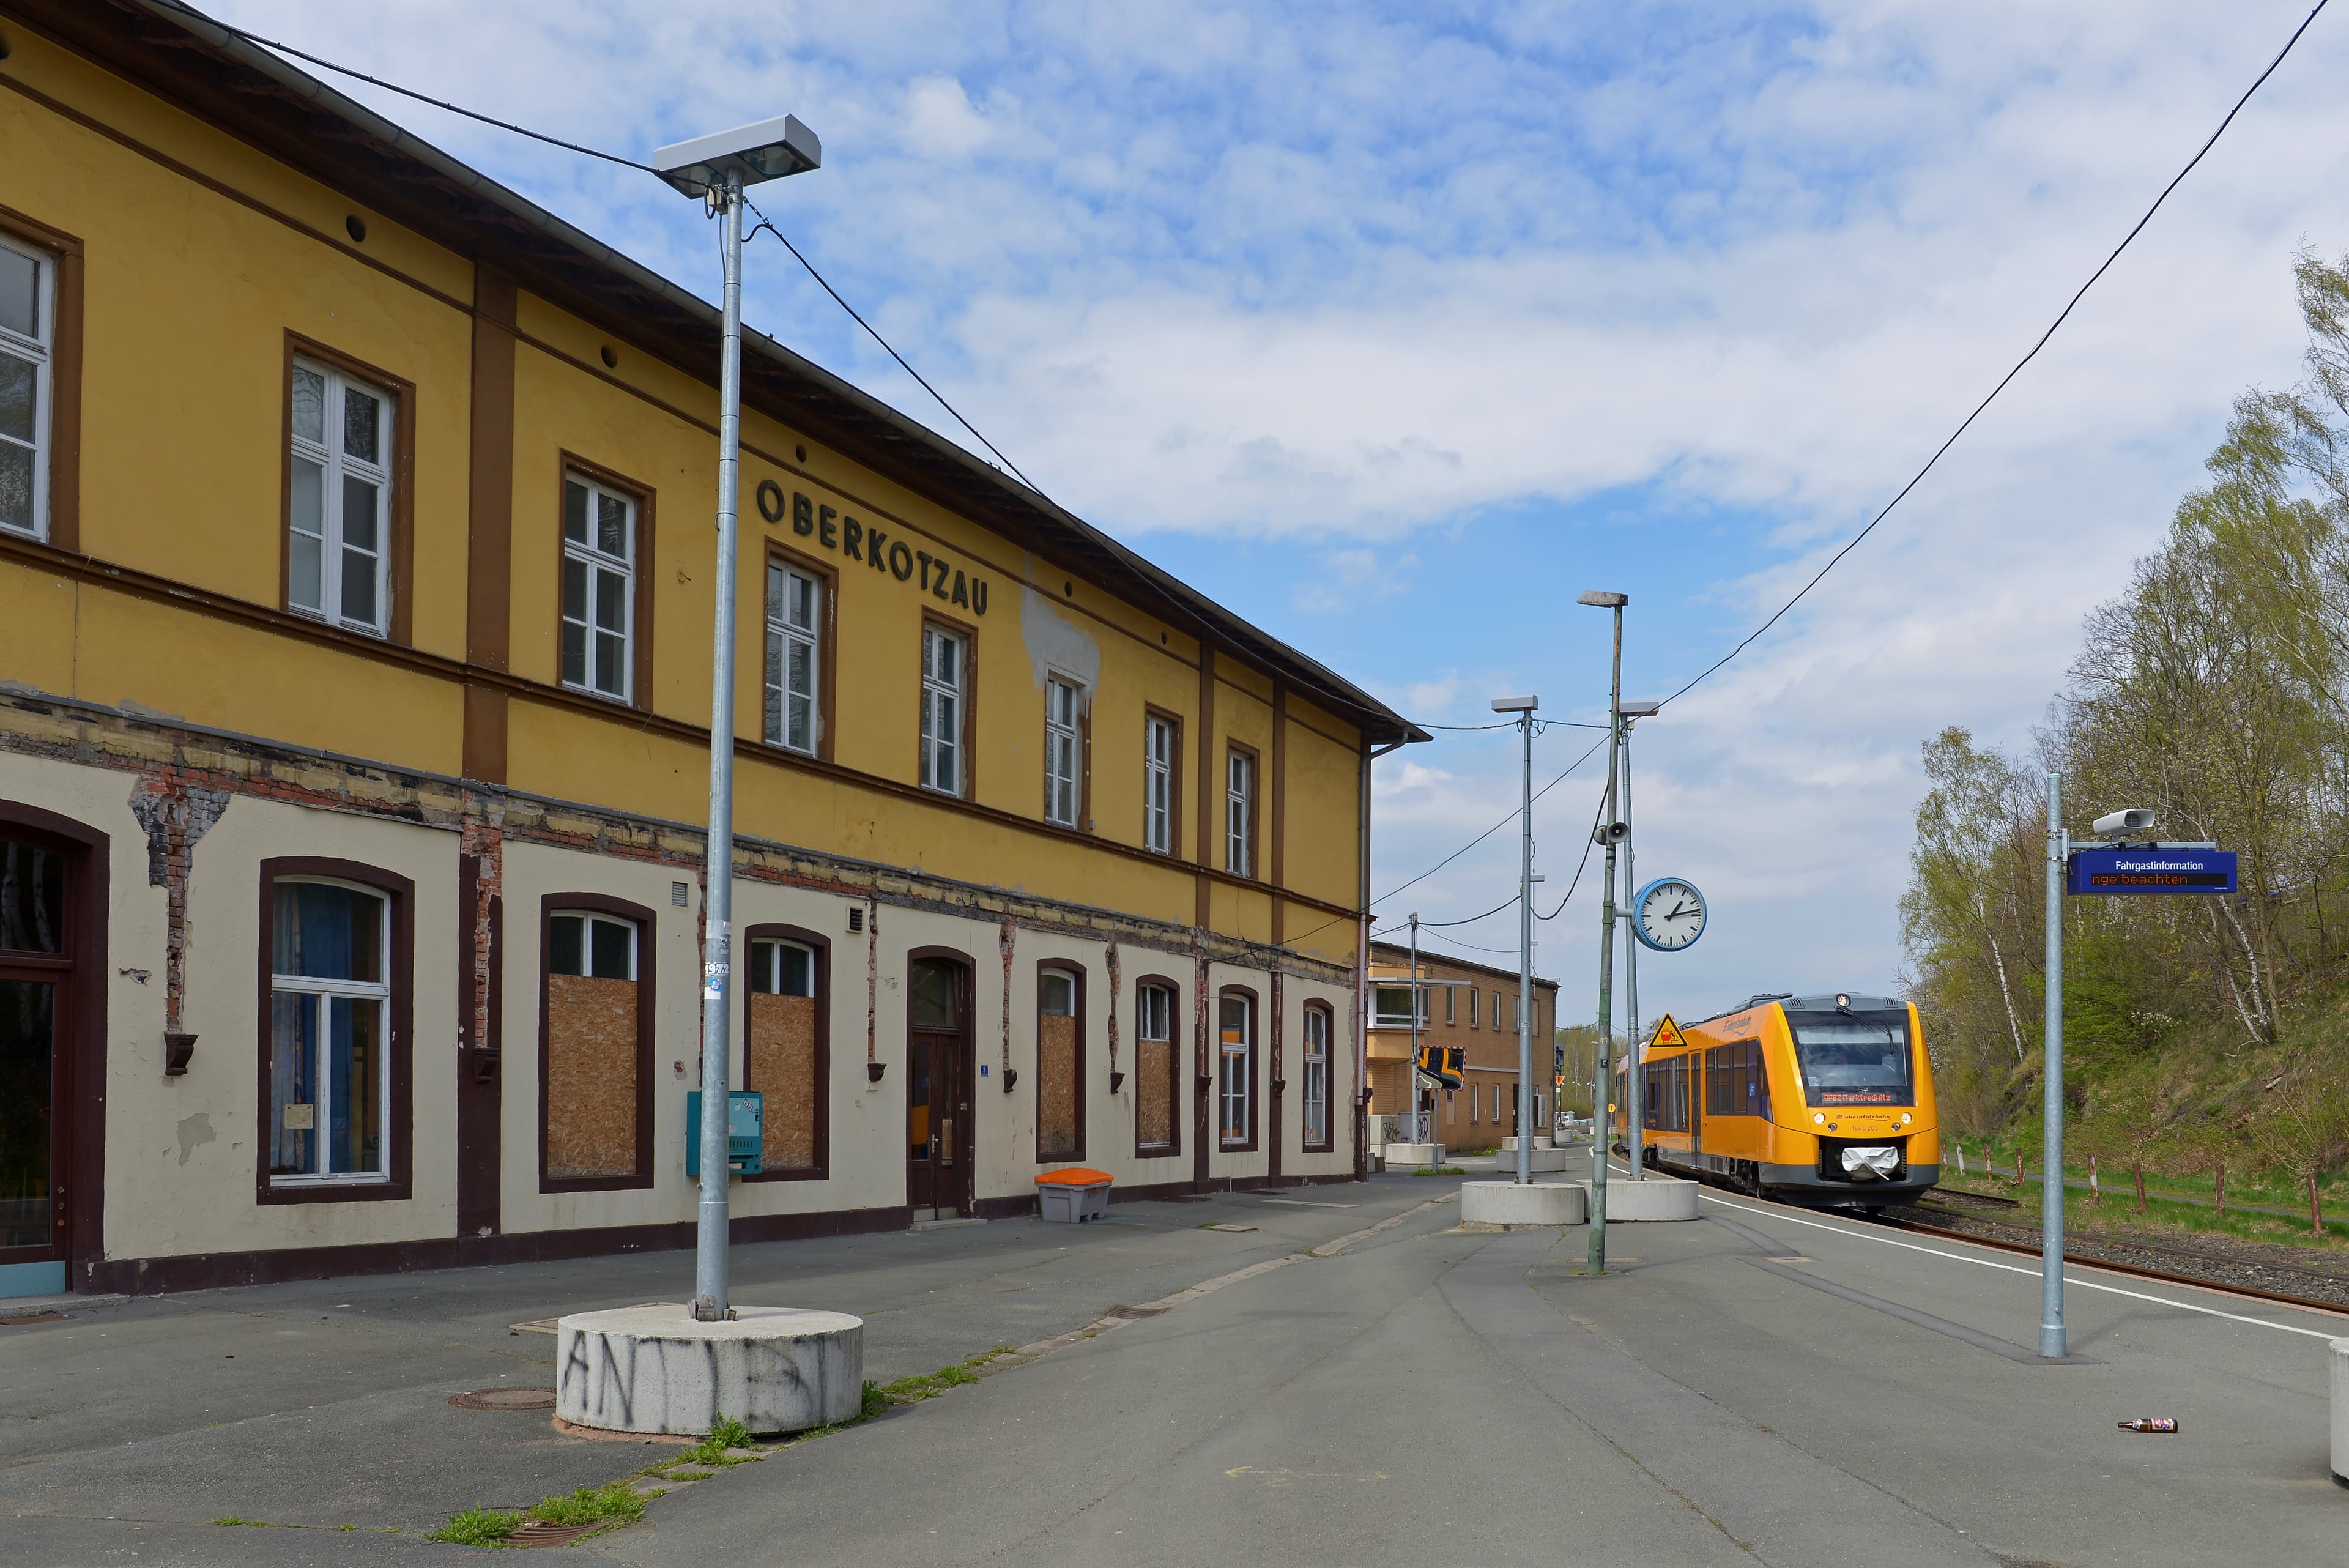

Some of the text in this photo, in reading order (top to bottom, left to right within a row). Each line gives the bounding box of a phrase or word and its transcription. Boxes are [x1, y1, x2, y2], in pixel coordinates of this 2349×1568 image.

[757, 479, 987, 615] OBERKOTZAU
[2115, 861, 2203, 872] Fahrgastinformation
[2091, 873, 2188, 886] nge beachten
